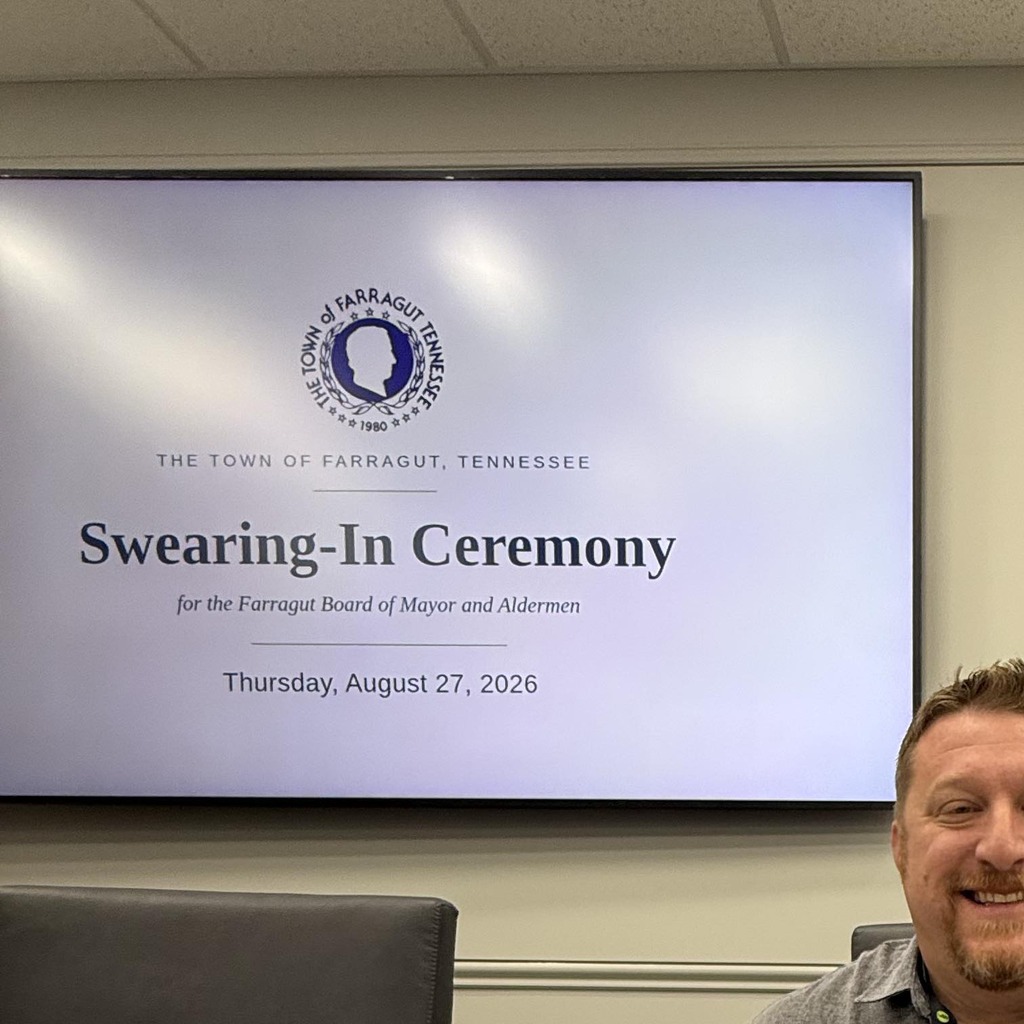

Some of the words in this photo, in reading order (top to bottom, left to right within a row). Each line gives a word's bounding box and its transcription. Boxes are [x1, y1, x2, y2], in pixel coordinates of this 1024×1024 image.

[321, 304, 336, 324] of
[335, 288, 424, 322] FARRAGUT
[300, 325, 322, 376] TOWN
[417, 321, 444, 410] TENNESSEE
[306, 378, 330, 409] THE
[360, 421, 388, 432] 1980
[156, 454, 197, 467] THE
[209, 454, 271, 467] TOWN
[284, 455, 310, 467] OF
[323, 455, 446, 470] FARRAGUT,
[457, 456, 589, 469] TENNESSEE
[81, 521, 395, 578] Swearing-In
[413, 524, 676, 580] Ceremony
[177, 594, 202, 615] for
[207, 595, 233, 611] the
[239, 596, 315, 616] Farragut
[321, 596, 373, 612] Board
[378, 596, 397, 617] of
[399, 597, 457, 617] Mayor
[462, 596, 493, 613] and
[497, 596, 580, 613] Aldermen
[223, 672, 337, 698] Thursday,
[346, 673, 427, 698] August
[436, 674, 470, 696] 27,
[481, 674, 537, 693] 2026
